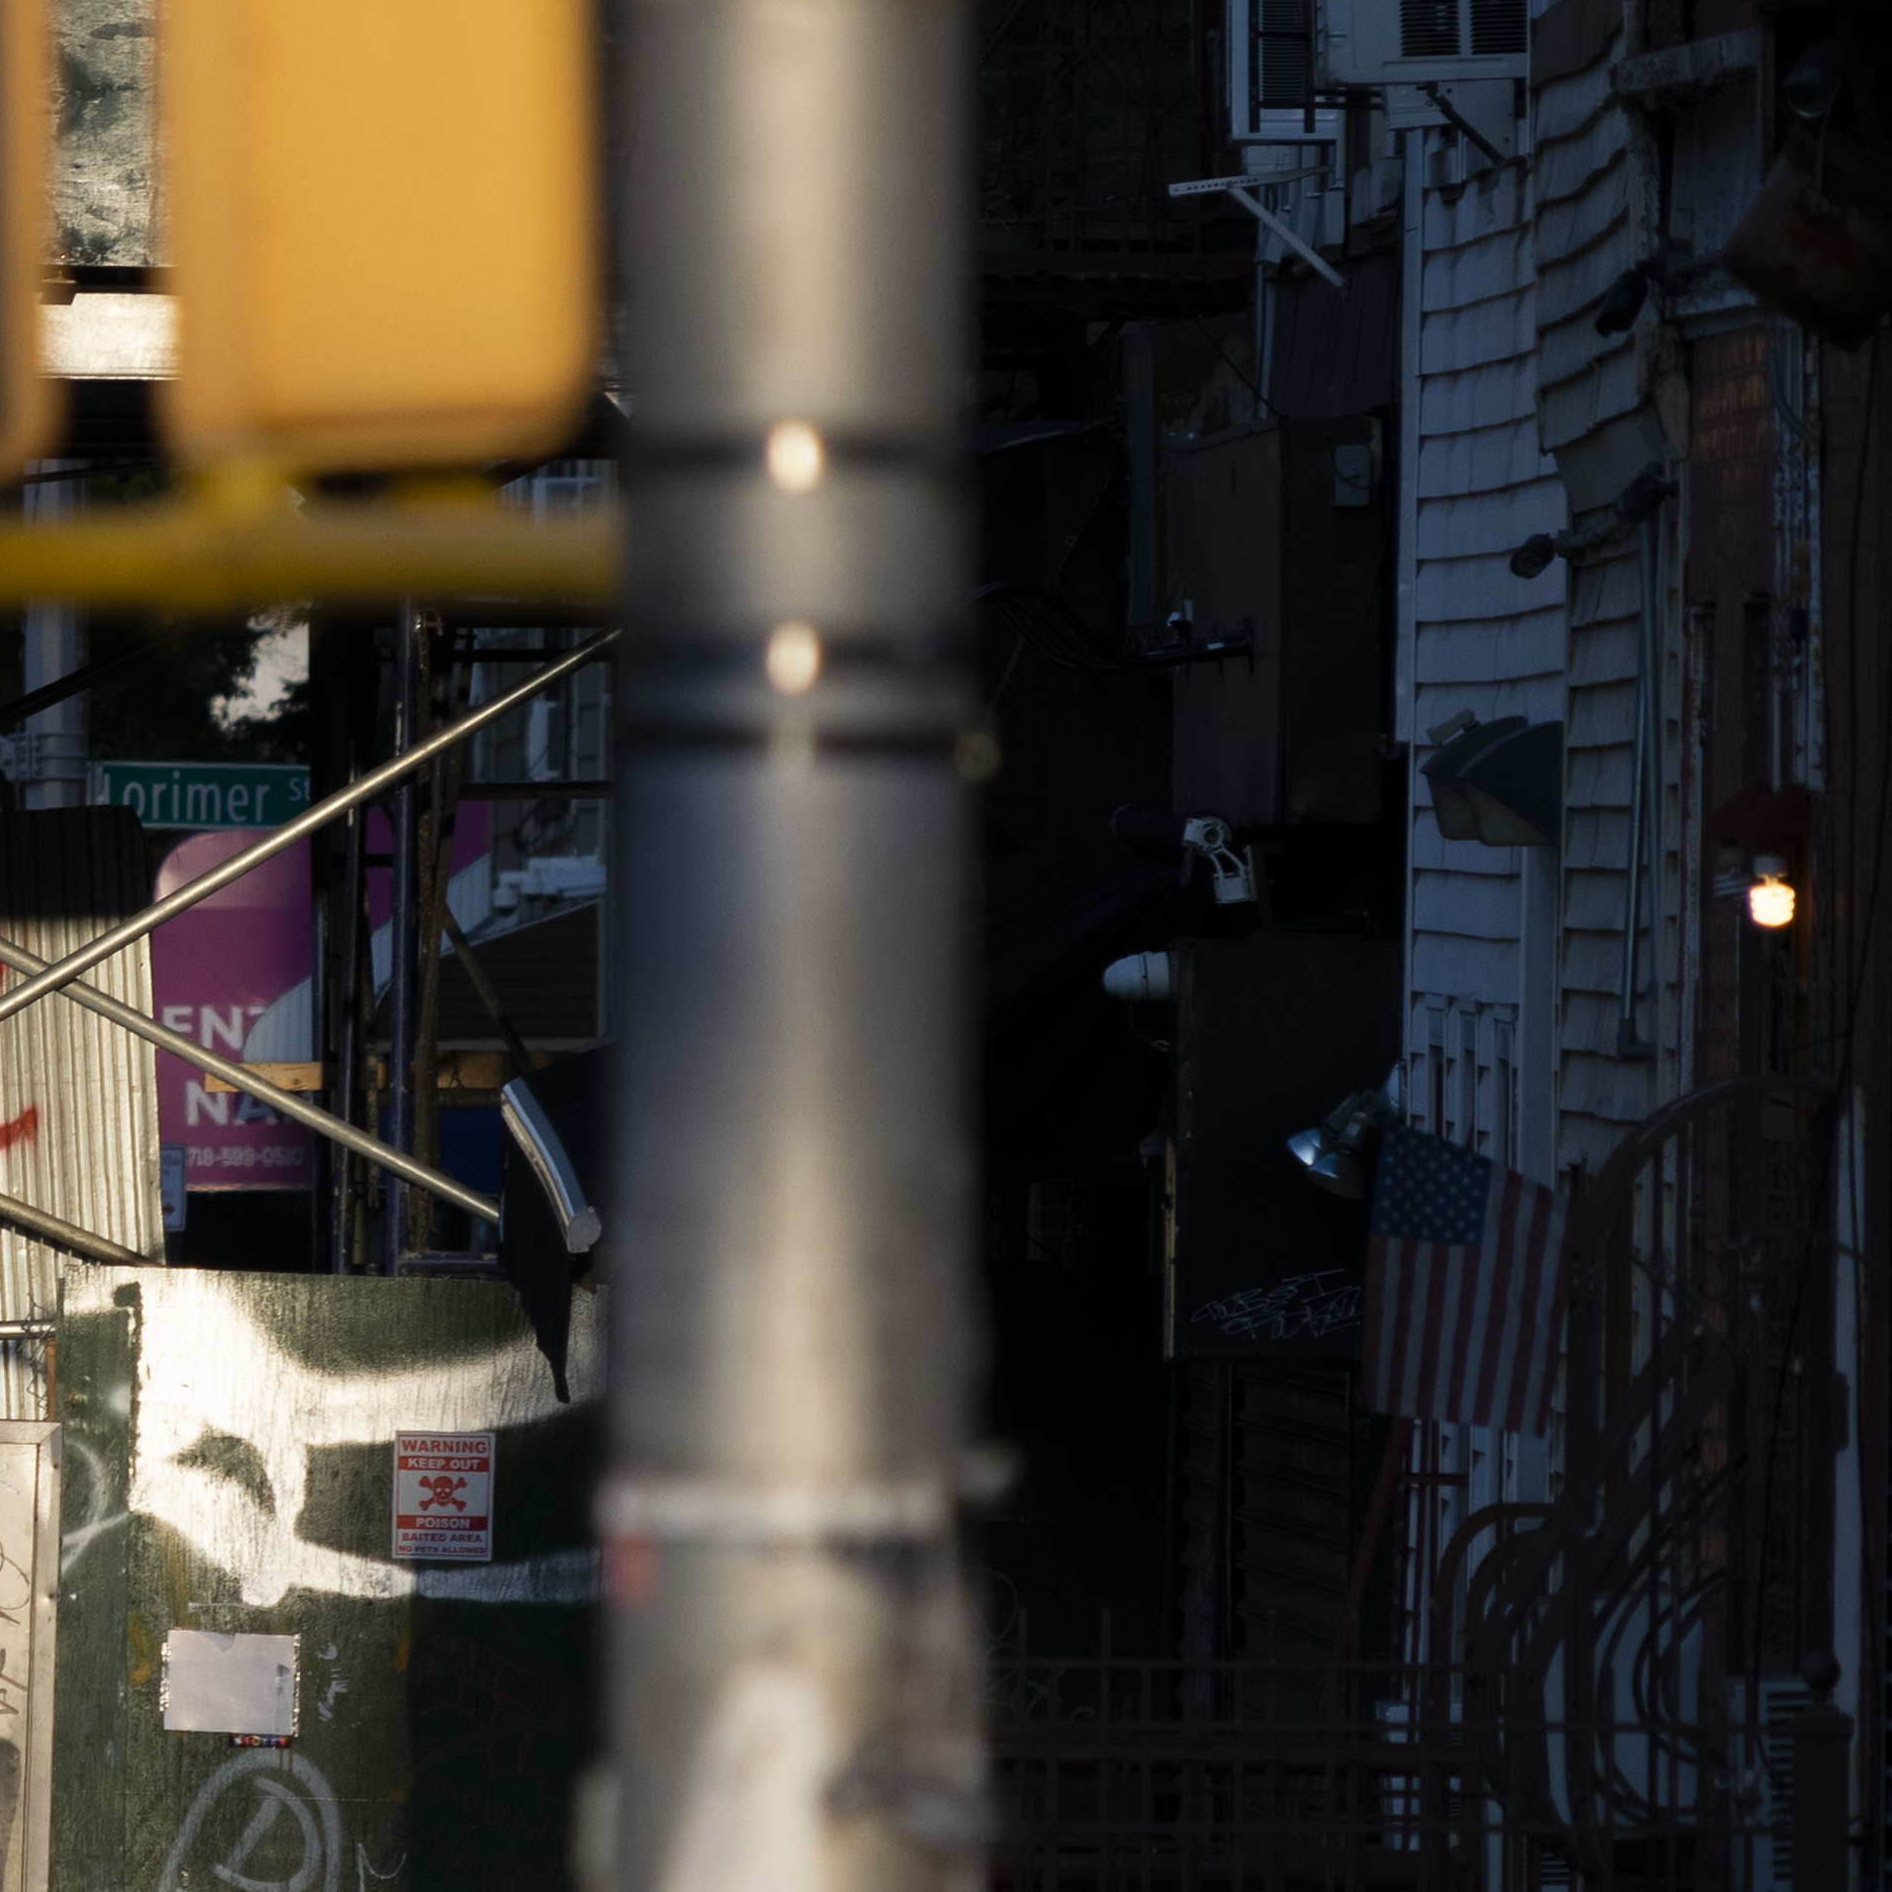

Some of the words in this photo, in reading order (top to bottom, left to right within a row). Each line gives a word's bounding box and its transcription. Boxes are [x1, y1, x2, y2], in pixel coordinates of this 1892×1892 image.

[401, 1440, 487, 1453] WARNING
[408, 1458, 445, 1468] KEEP
[450, 1459, 480, 1469] OUT
[416, 1518, 470, 1528] POISON
[402, 1533, 446, 1542] BAITED
[450, 1534, 483, 1542] AREA
